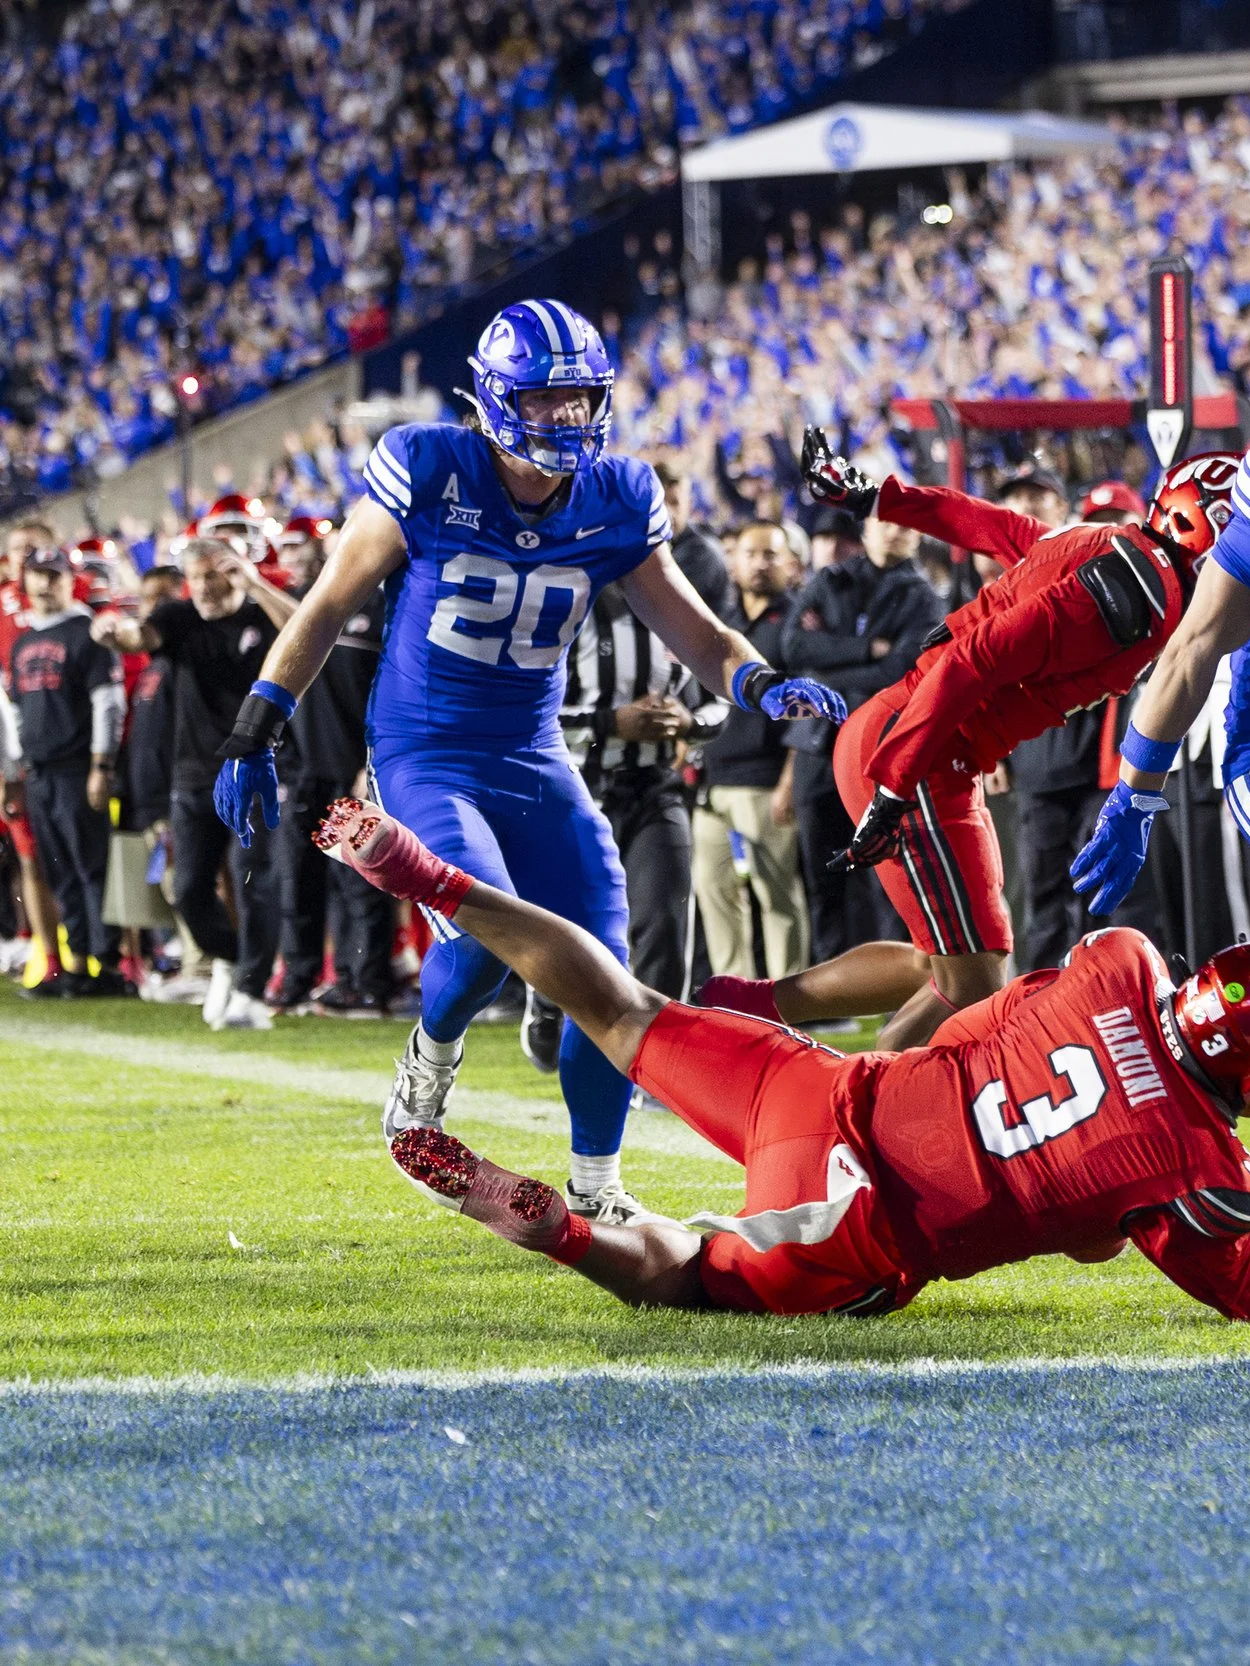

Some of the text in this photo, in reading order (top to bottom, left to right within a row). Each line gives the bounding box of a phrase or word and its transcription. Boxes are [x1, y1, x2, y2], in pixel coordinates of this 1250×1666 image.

[564, 366, 582, 377] BYU
[1200, 459, 1239, 486] U
[441, 473, 459, 502] A
[447, 507, 481, 530] XII
[519, 533, 537, 546] Y
[426, 553, 591, 669] 20
[1160, 1009, 1183, 1061] UTES
[1201, 1033, 1229, 1057] 3
[1092, 1006, 1168, 1107] DAMUNI
[974, 1044, 1107, 1158] 3
